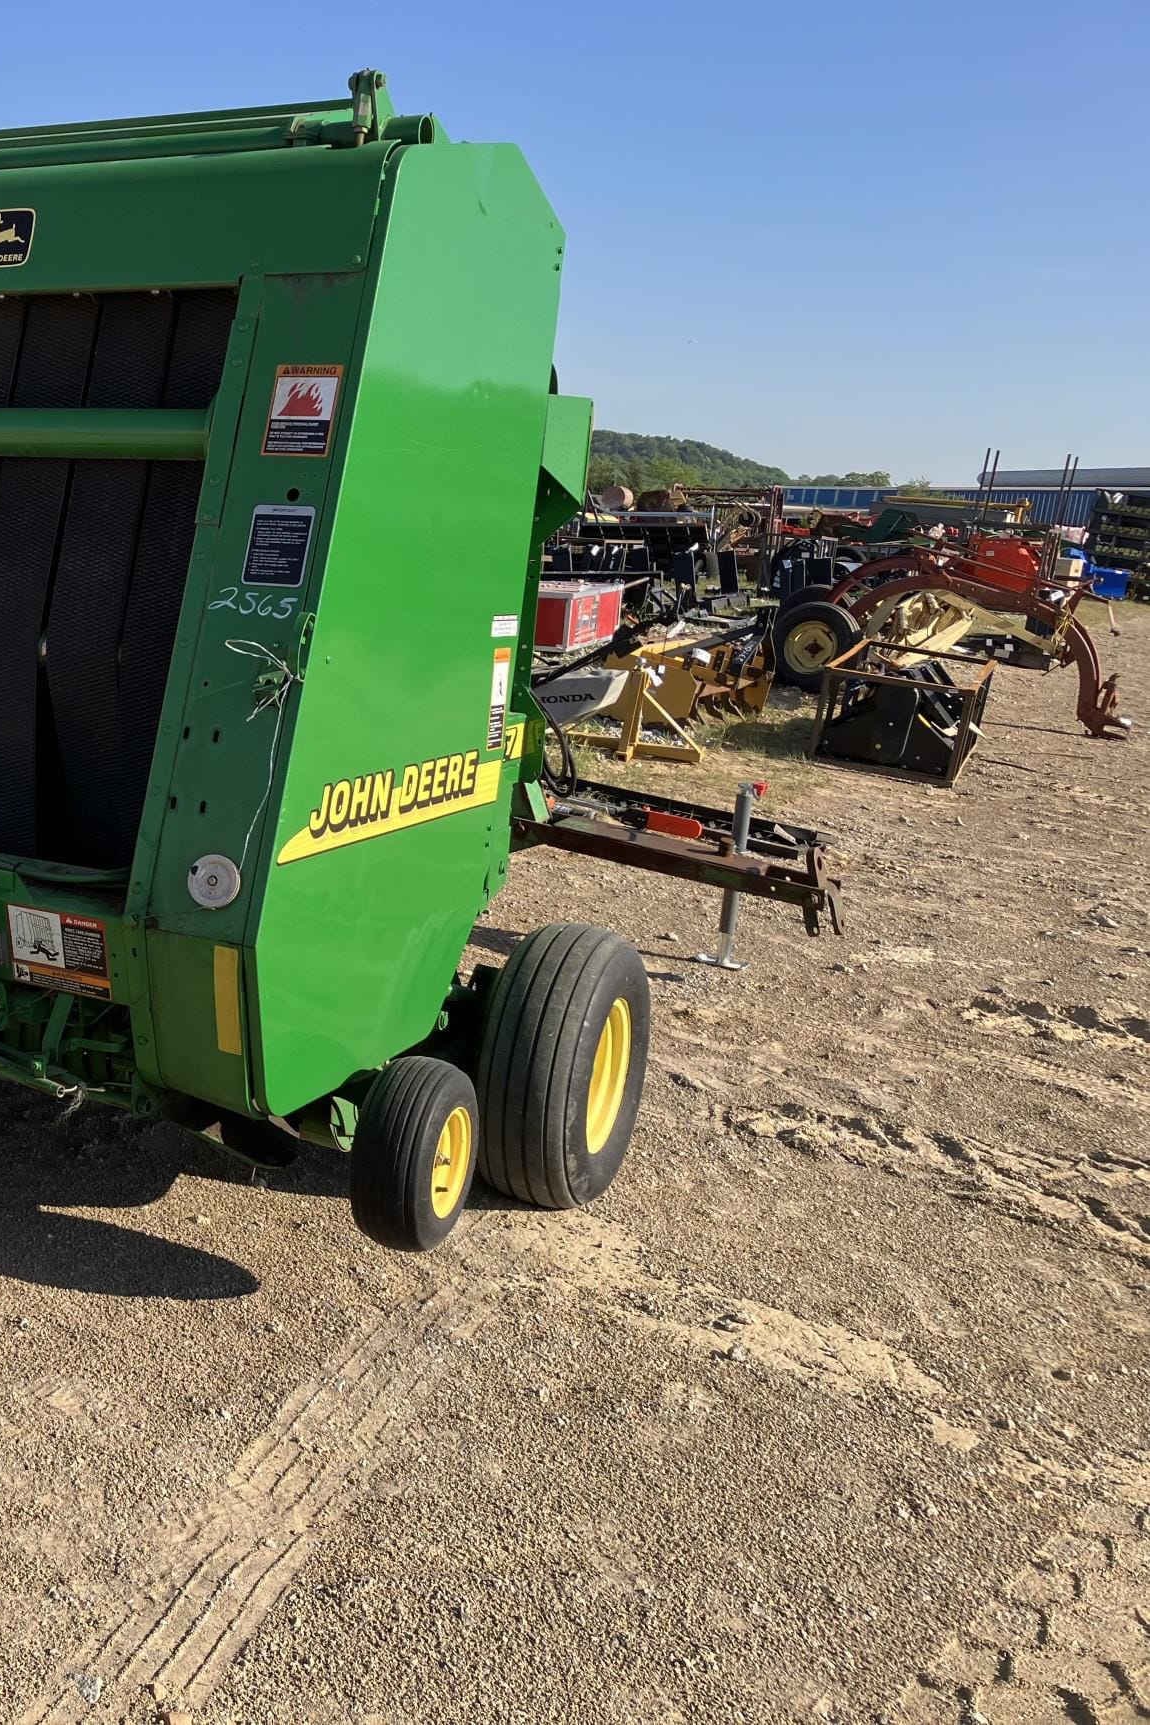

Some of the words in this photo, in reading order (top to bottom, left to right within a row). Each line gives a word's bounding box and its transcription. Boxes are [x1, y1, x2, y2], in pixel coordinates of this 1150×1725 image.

[291, 366, 337, 375] WARNING
[208, 586, 299, 619] 2565
[309, 769, 395, 838] JOHN
[398, 749, 479, 814] DEERE
[73, 919, 98, 929] DANGER
